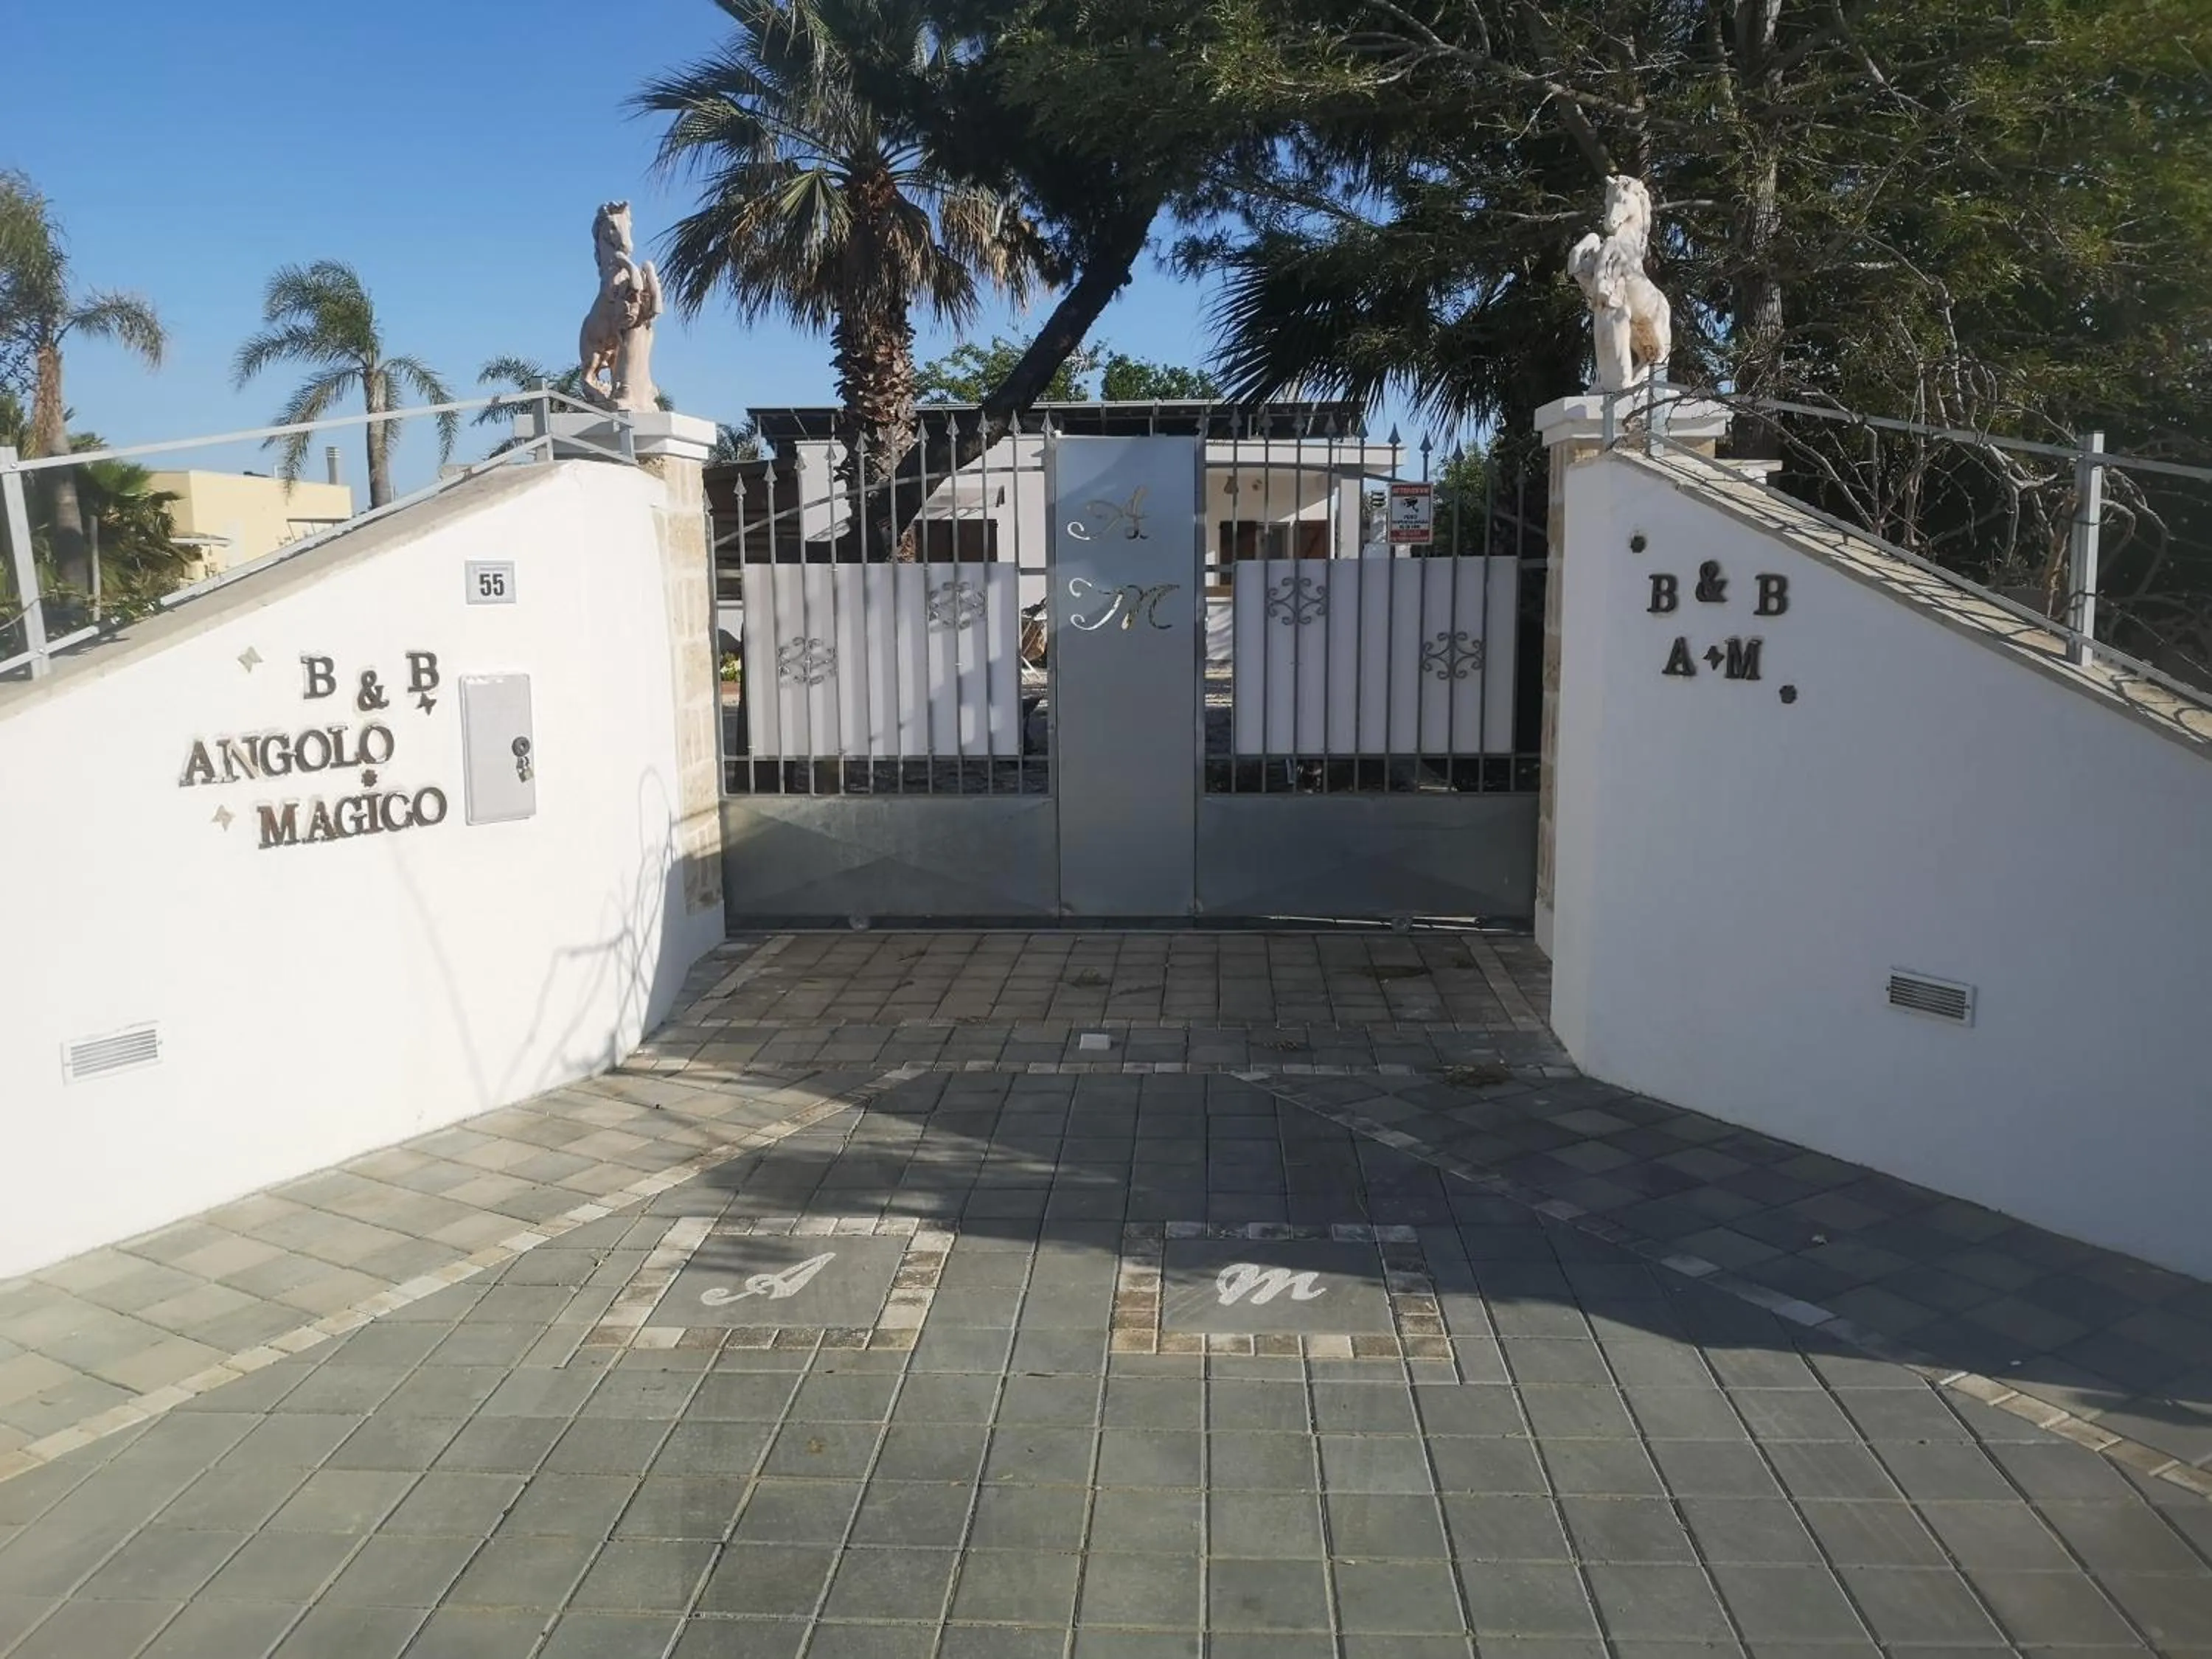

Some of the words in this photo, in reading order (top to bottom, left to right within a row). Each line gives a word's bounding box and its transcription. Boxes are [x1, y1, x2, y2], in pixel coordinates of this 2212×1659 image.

[479, 573, 504, 596] 55
[1646, 574, 1679, 613] B
[1695, 560, 1728, 602] &
[1753, 574, 1790, 616] B
[300, 654, 337, 700] B
[356, 669, 389, 712] &
[406, 650, 440, 693] B
[1662, 636, 1697, 676] A
[1724, 636, 1763, 680] M
[178, 723, 395, 787] ANGOLO
[257, 786, 448, 849] MAGICO
